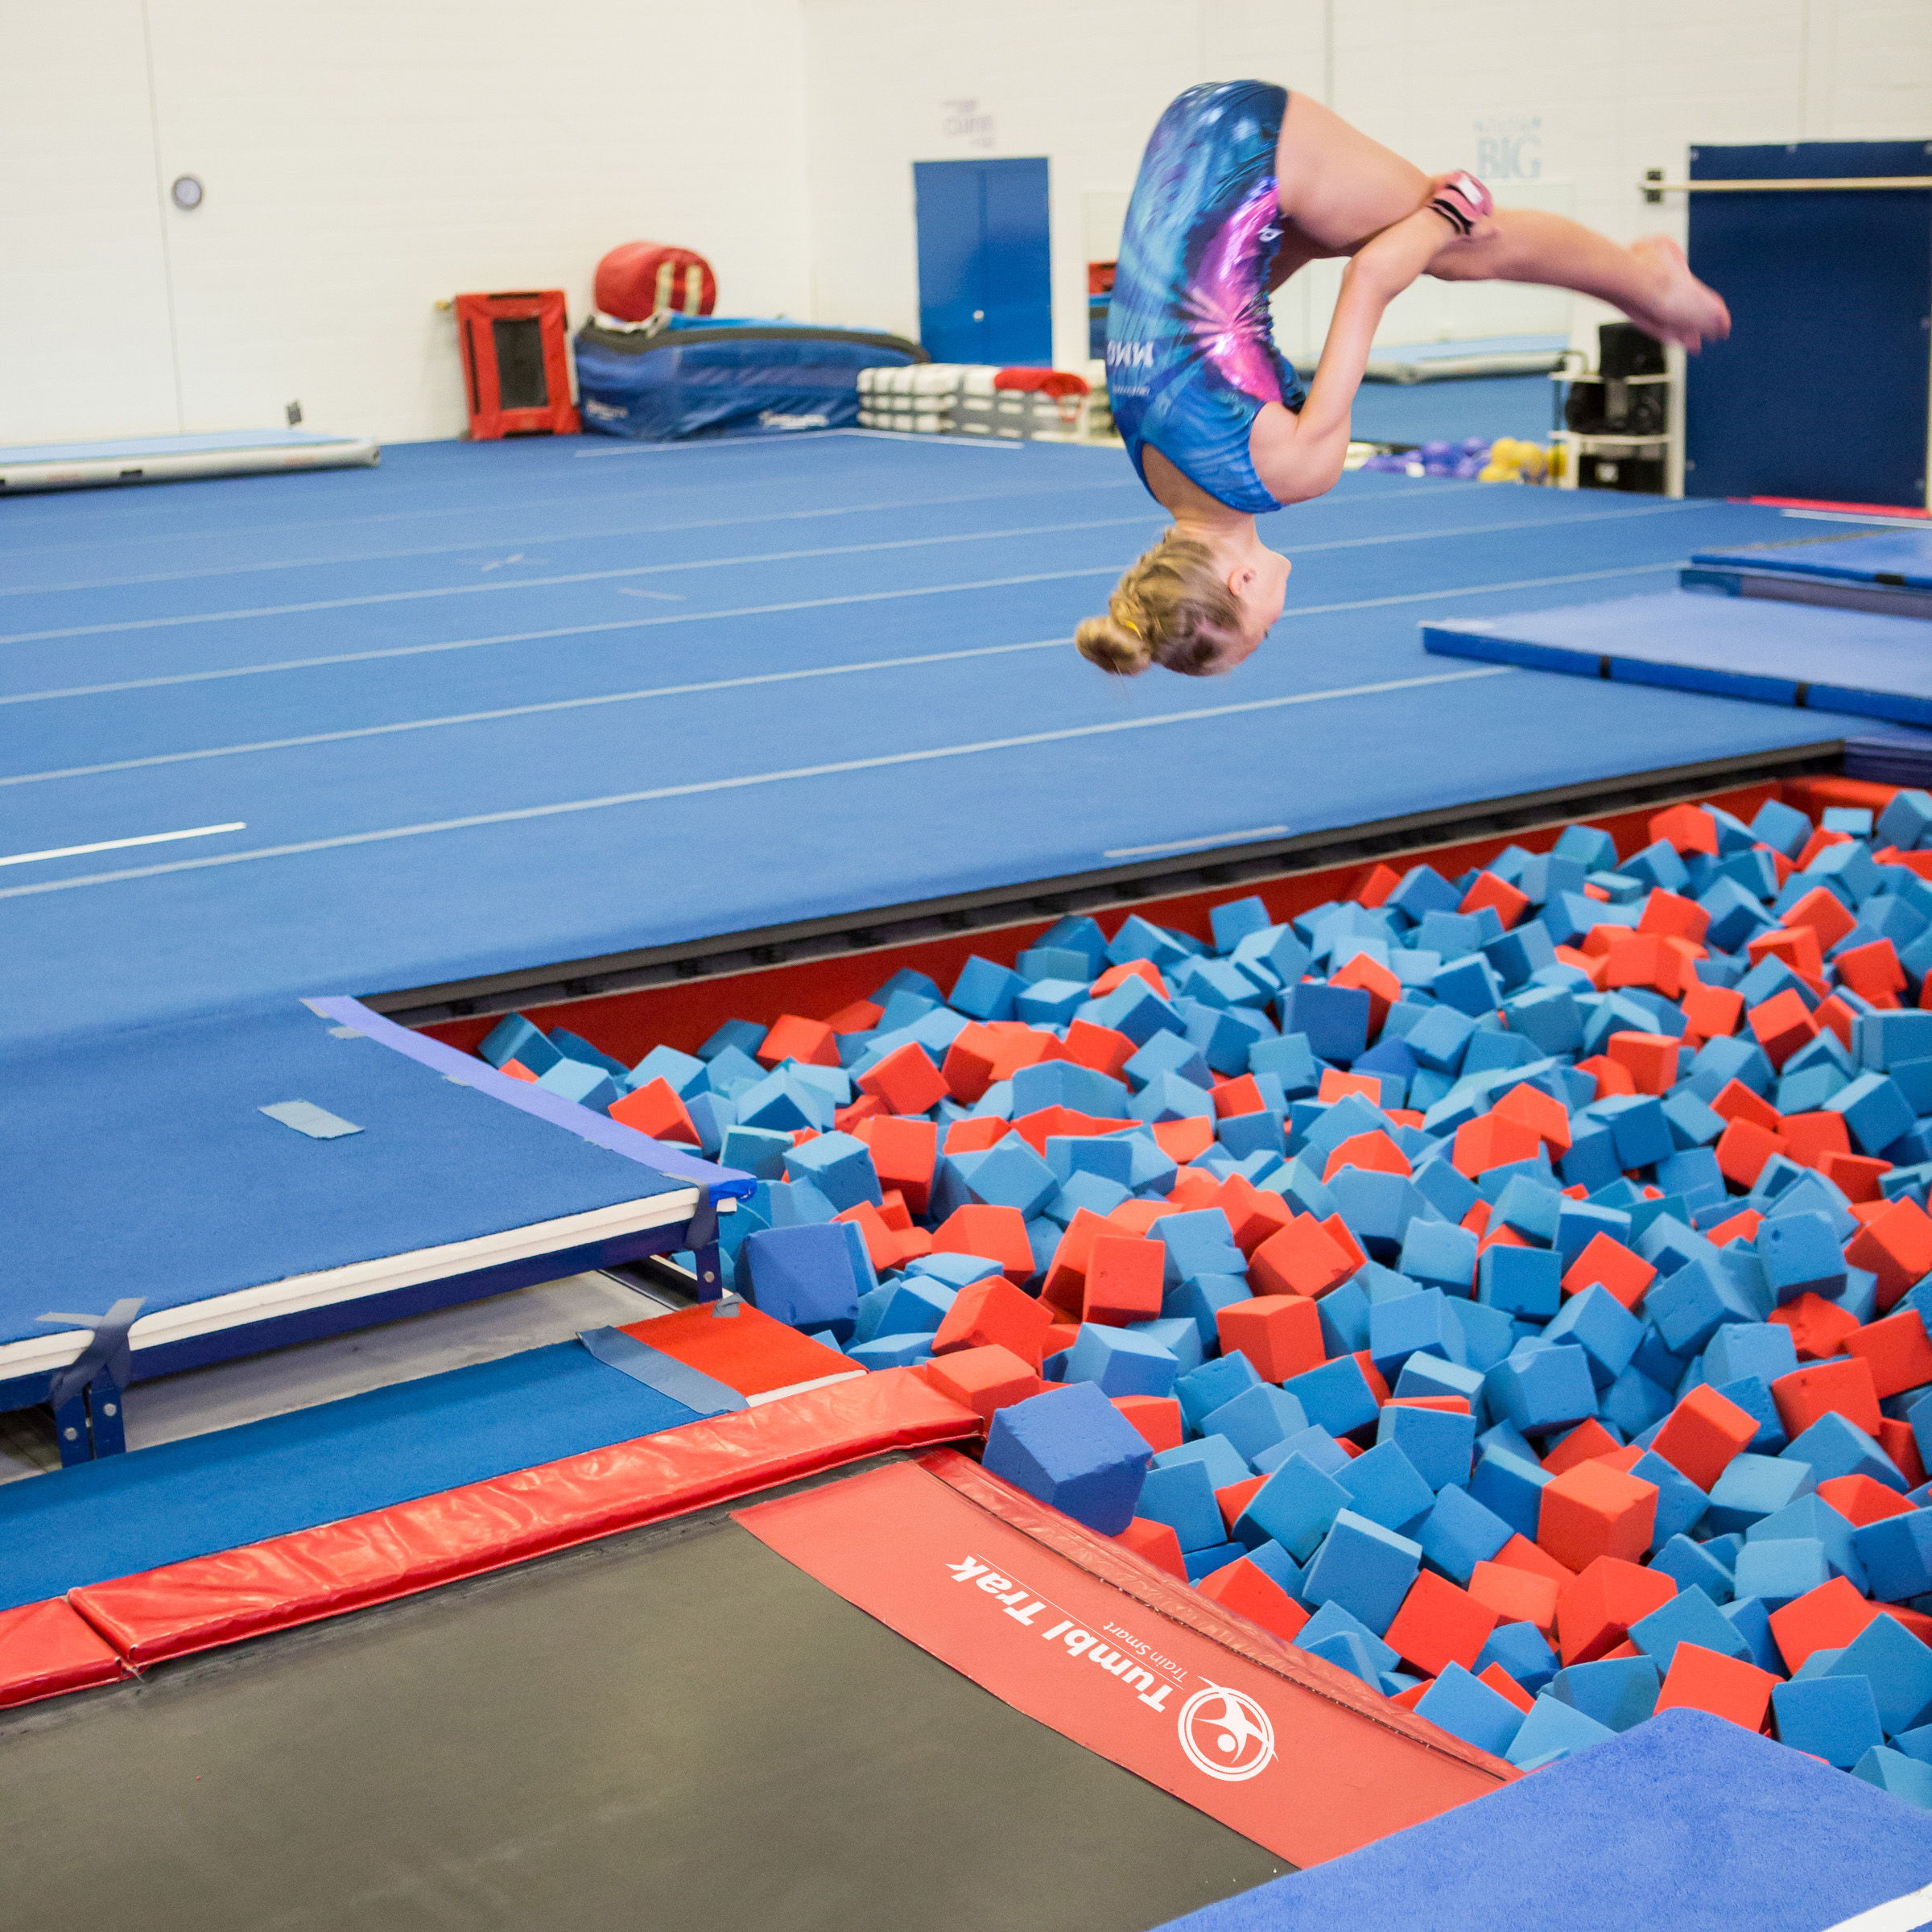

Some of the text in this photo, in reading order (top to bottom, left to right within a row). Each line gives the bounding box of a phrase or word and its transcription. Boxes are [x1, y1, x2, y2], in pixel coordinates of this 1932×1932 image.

[945, 1554, 1174, 1713] Tumbl Trak
[1103, 1621, 1189, 1683] Train Smart
